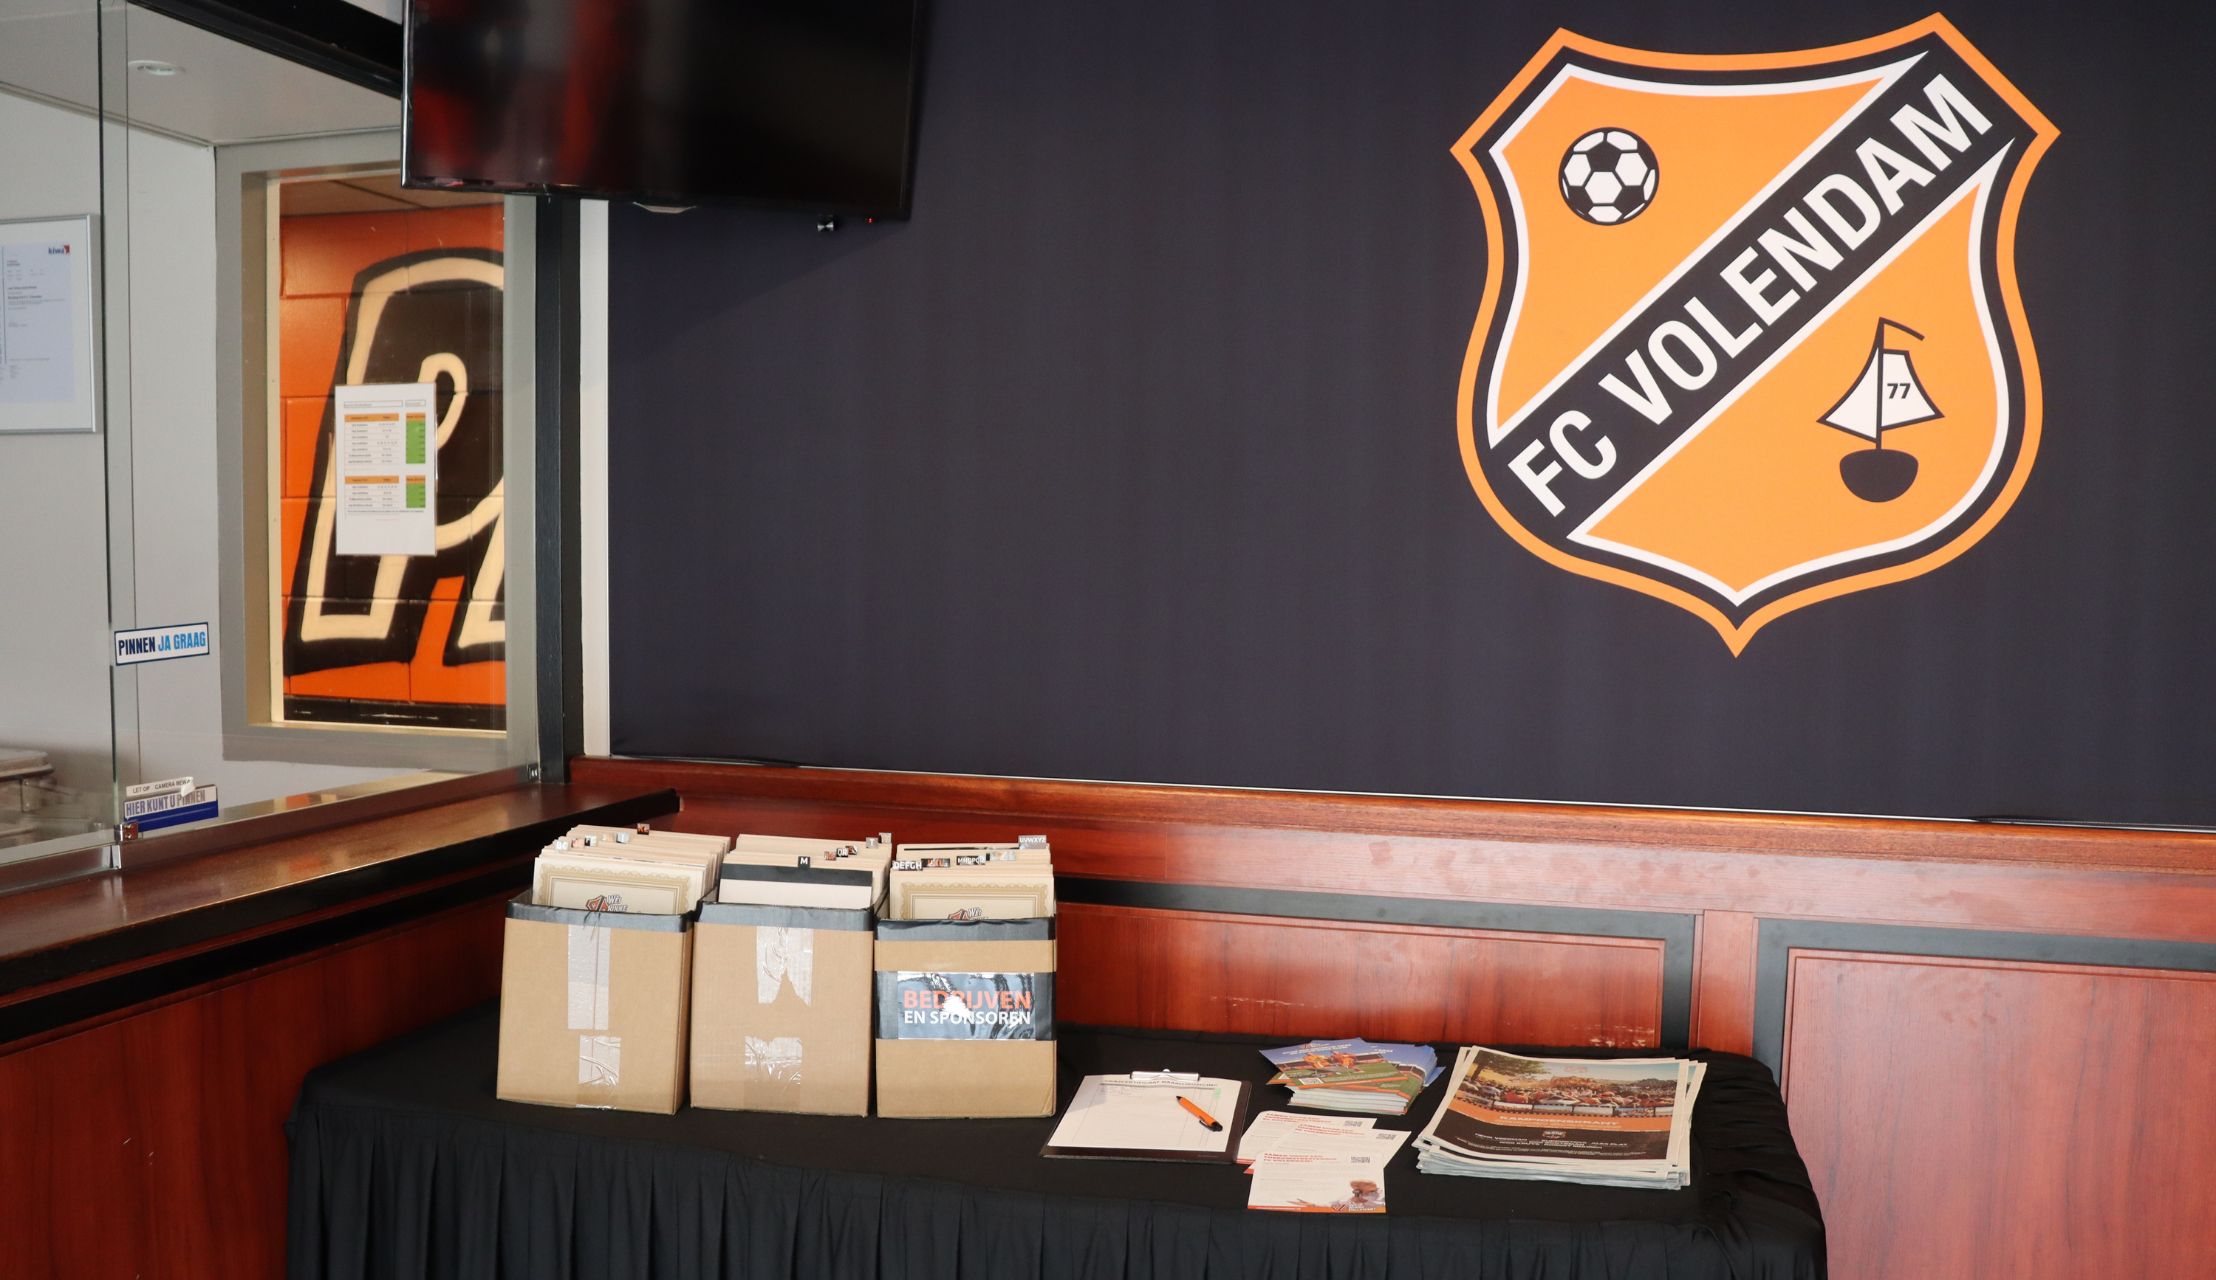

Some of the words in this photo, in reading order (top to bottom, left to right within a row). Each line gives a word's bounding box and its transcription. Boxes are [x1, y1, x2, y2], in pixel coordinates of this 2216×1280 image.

[1507, 409, 1617, 518] FC
[1598, 73, 1994, 426] VOLENDAM
[1886, 382, 1912, 401] 77
[118, 636, 156, 656] PINNEN
[158, 634, 172, 652] JA
[173, 631, 207, 650] GRAAG
[132, 786, 142, 794] LET
[154, 780, 175, 790] CAMERA
[126, 800, 146, 817] HIER
[146, 796, 169, 812] KUNT
[169, 794, 176, 808] U
[800, 856, 808, 865] M
[892, 860, 922, 870] DEFGH
[904, 1011, 926, 1024] EN
[929, 1011, 1032, 1025] SPONSOREN
